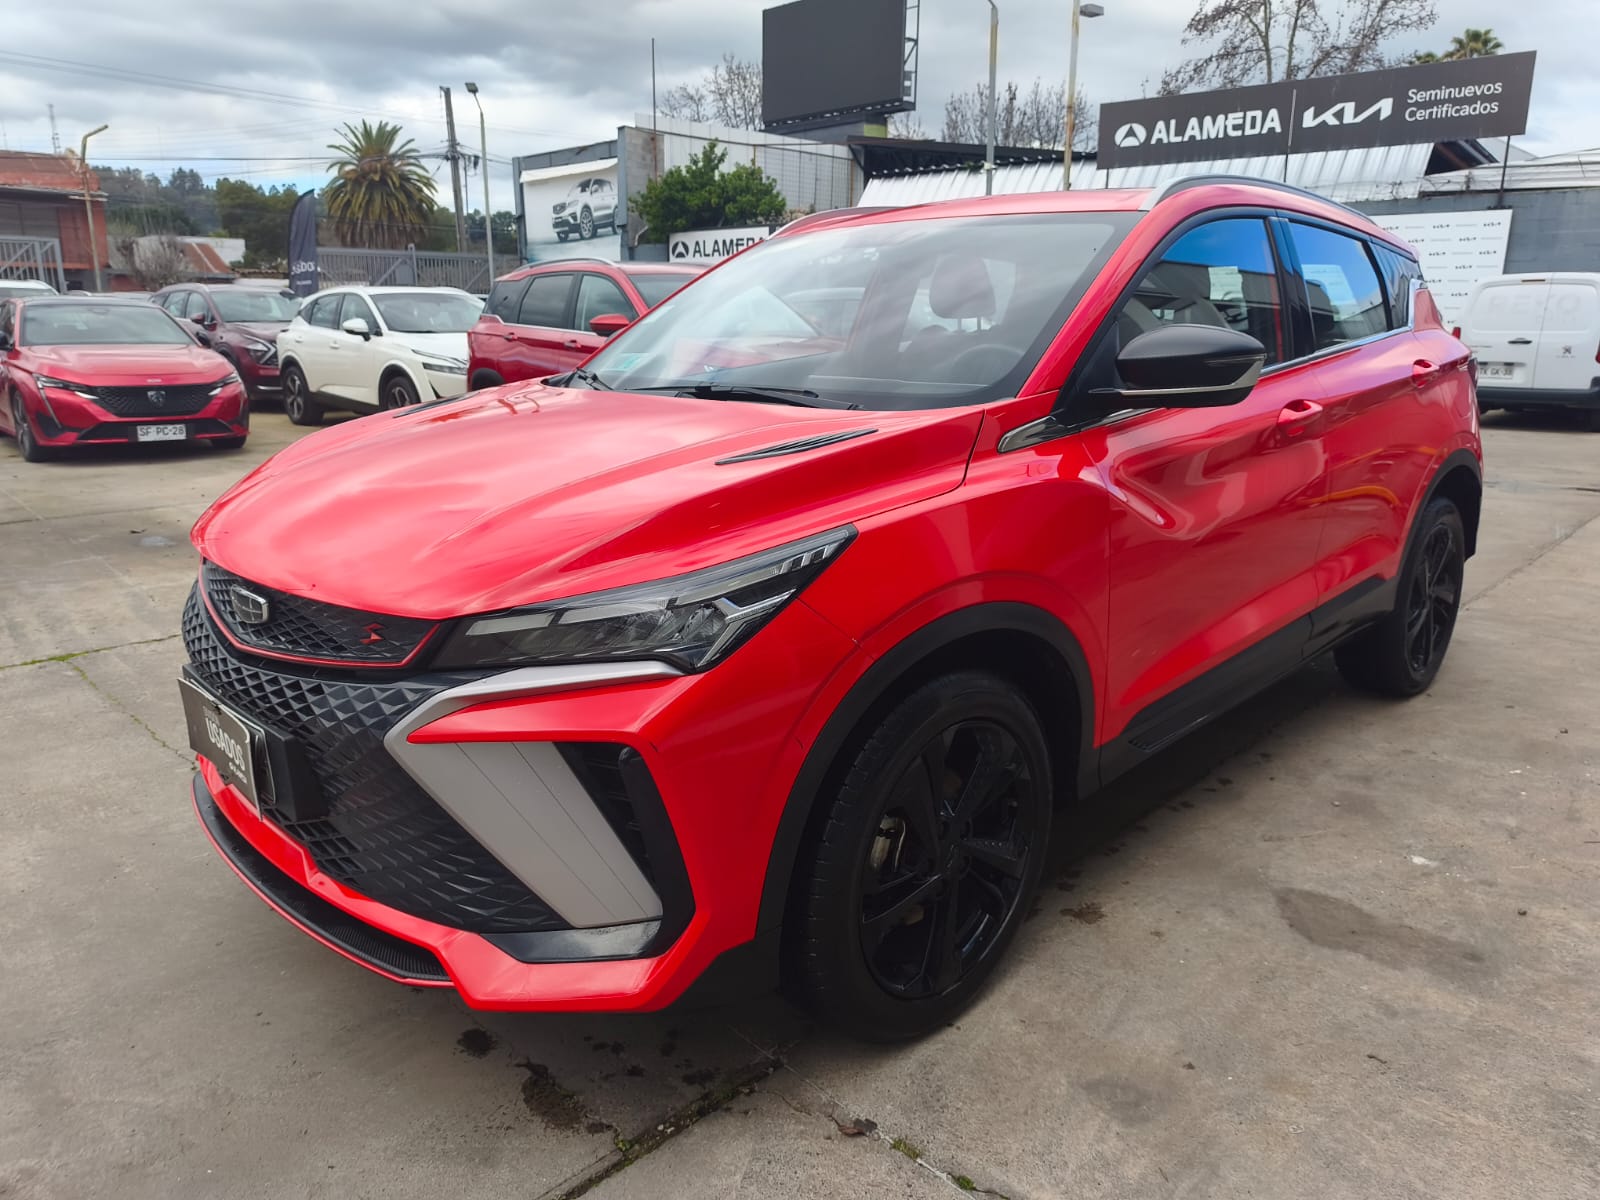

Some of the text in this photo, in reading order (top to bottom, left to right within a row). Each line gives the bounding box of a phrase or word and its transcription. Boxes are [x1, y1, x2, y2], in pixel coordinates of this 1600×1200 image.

[1407, 82, 1503, 103] Seminuevos
[1302, 97, 1394, 128] KIA
[1404, 100, 1500, 121] Certificados
[1150, 108, 1282, 144] ALAMEDA
[693, 237, 764, 258] ALAME
[205, 717, 246, 772] USADOS
